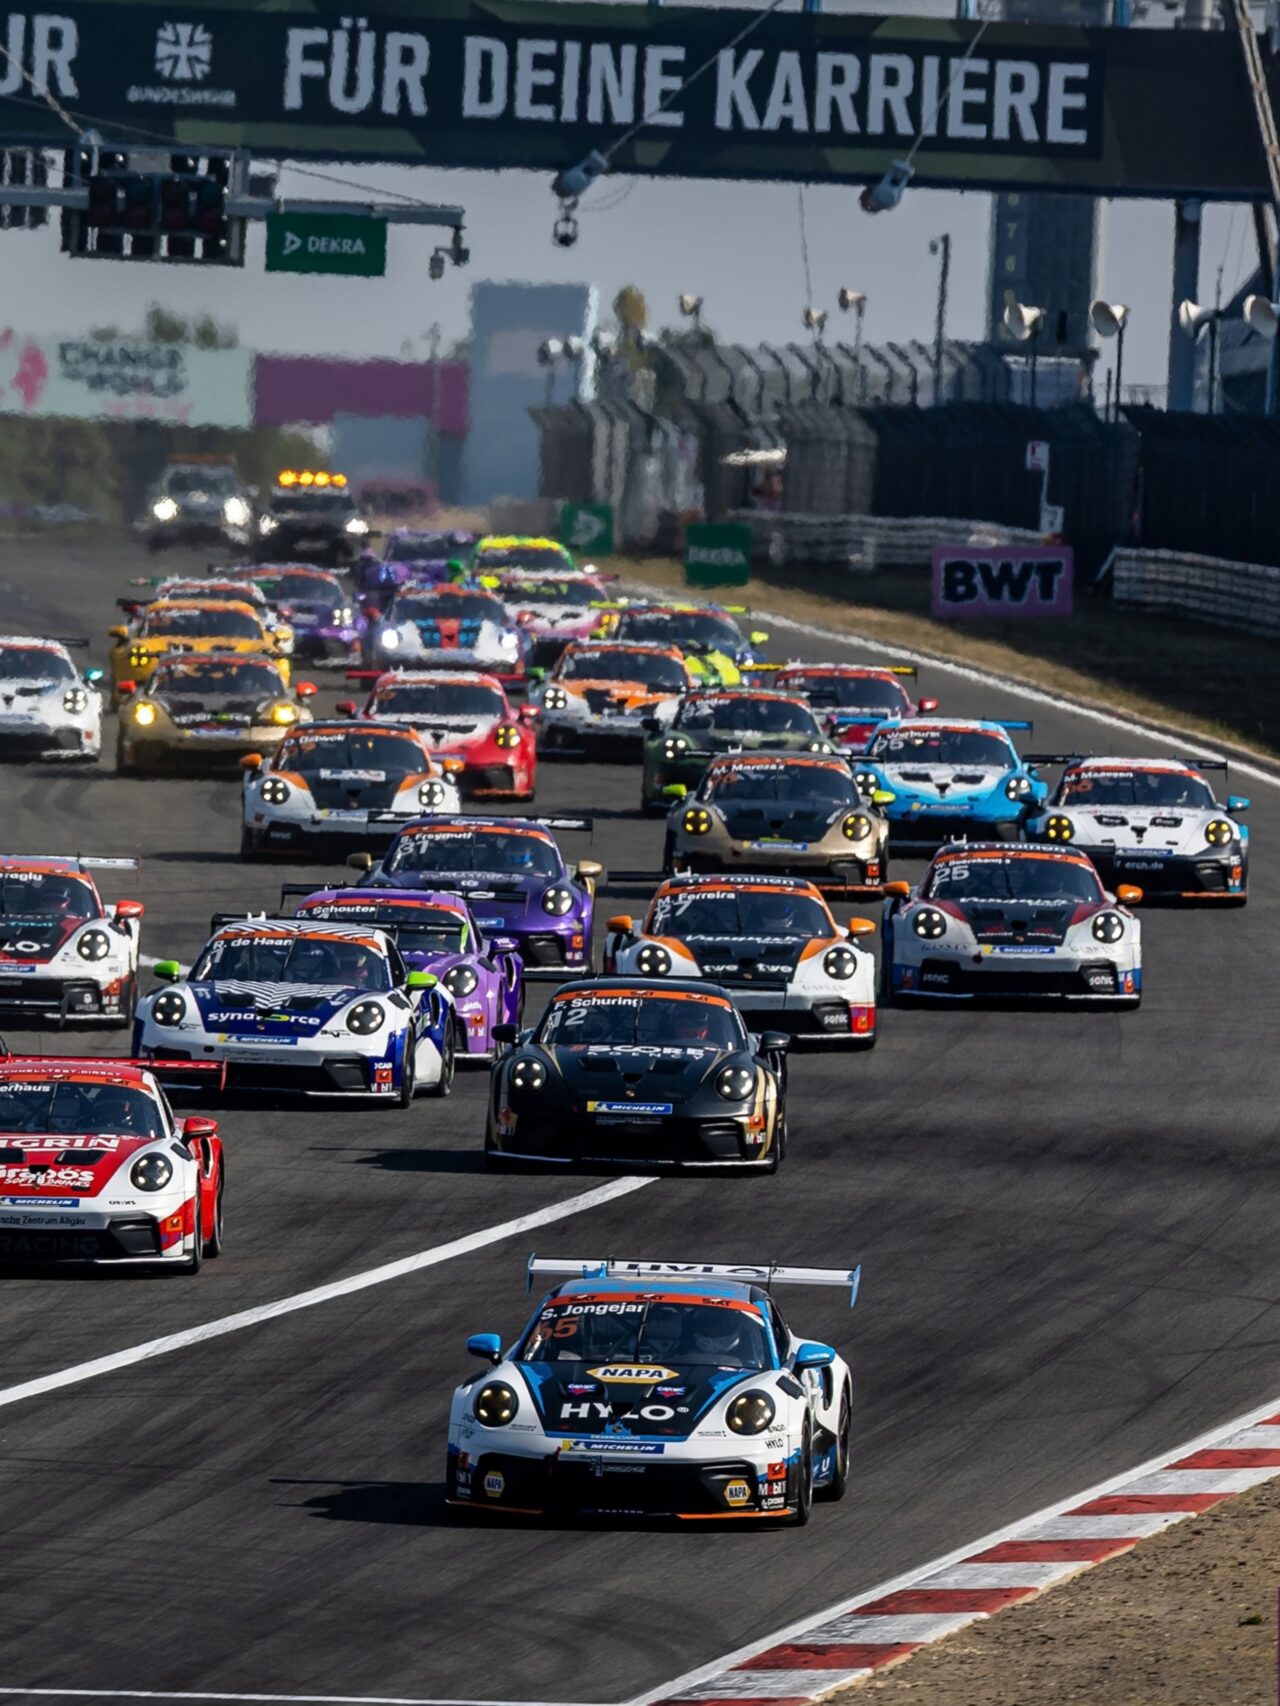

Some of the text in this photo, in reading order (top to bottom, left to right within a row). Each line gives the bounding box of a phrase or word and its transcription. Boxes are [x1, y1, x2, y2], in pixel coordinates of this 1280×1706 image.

[284, 20, 1088, 145] FÜR DEINE KARRIERE
[306, 236, 365, 256] DEKRA
[943, 558, 1066, 604] BWT
[933, 864, 970, 883] 25
[678, 890, 736, 901] Ferreira
[231, 937, 251, 947] de
[254, 938, 293, 946] Haan
[554, 1001, 567, 1010] F.
[611, 1104, 665, 1113] MICHELIN
[14, 1198, 73, 1207] MICHELIN
[23, 1215, 57, 1226] Zentrum
[541, 1308, 558, 1320] S.
[600, 1367, 666, 1380] NAPA
[590, 1443, 656, 1452] MICHELIN
[766, 1438, 784, 1450] HYLO
[486, 1476, 503, 1490] NAPA
[728, 1486, 747, 1499] NAPA
